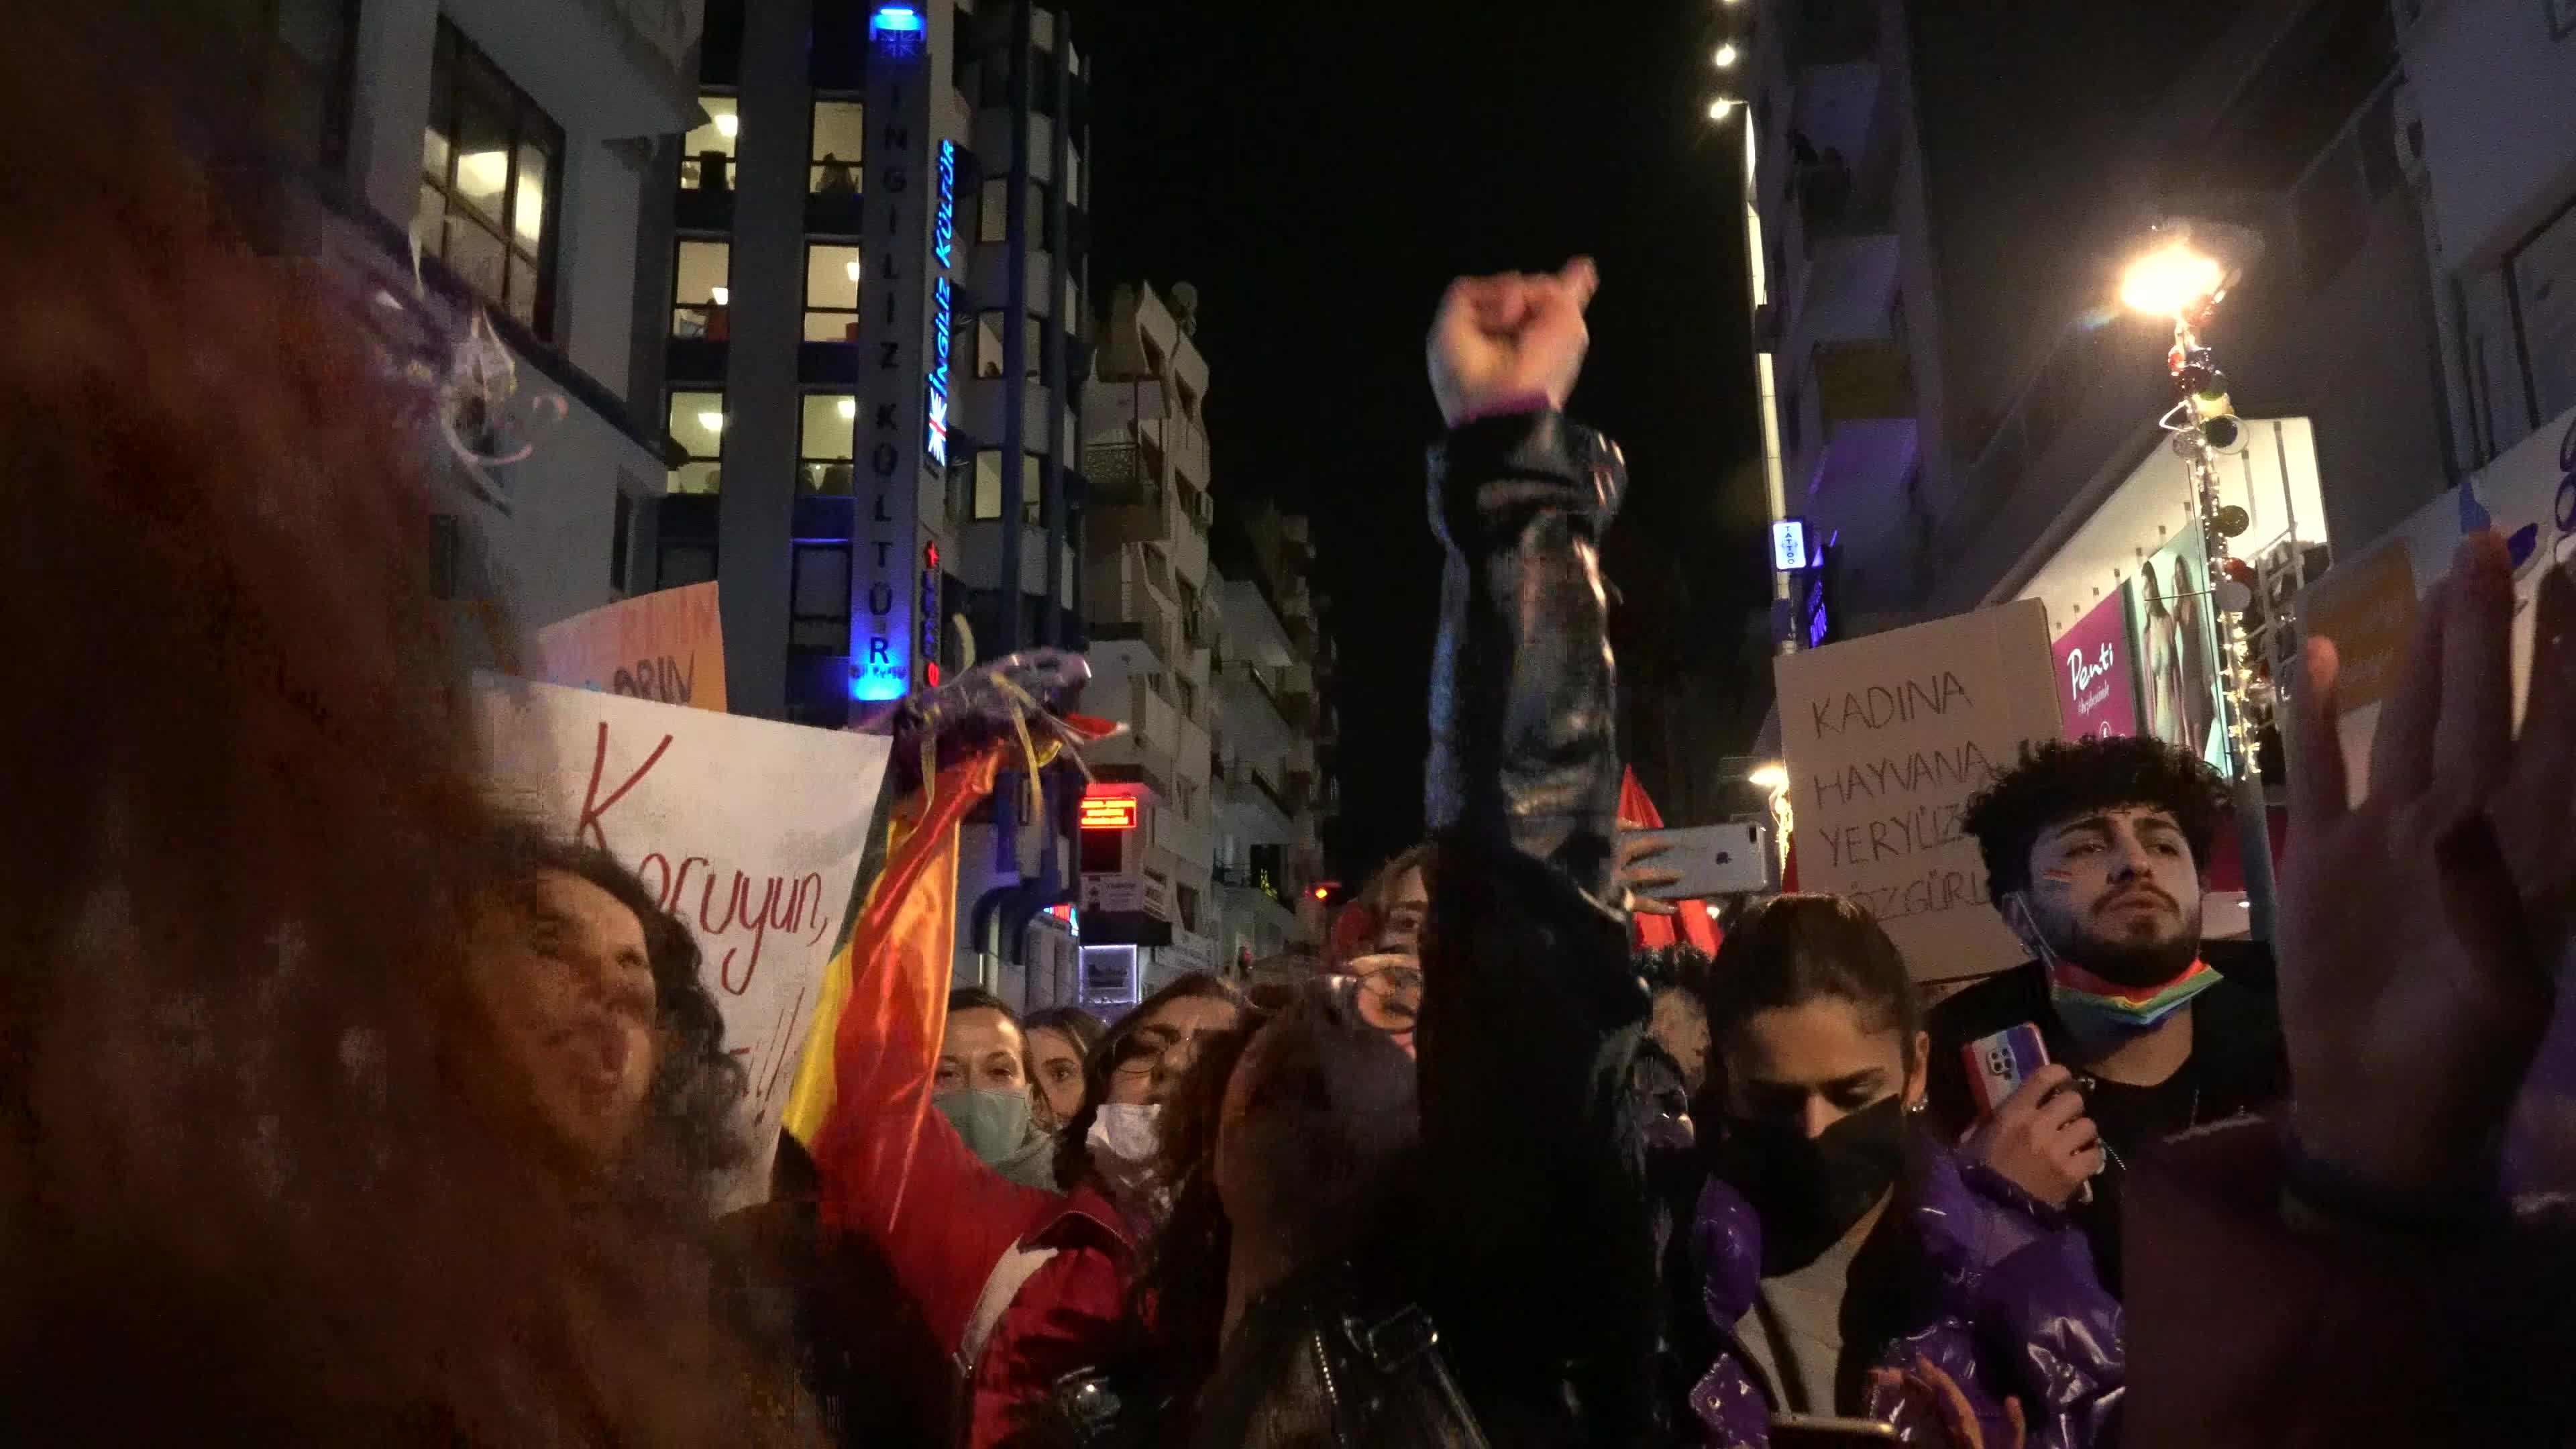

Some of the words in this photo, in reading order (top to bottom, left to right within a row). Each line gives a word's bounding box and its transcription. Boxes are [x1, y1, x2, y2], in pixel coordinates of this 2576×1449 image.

[934, 138, 954, 269] KÜLTÜR
[1784, 526, 1794, 564] TATTOO
[1812, 671, 1974, 738] KADINA
[2067, 642, 2114, 701] Penti
[1814, 741, 1997, 809] HAYVANA
